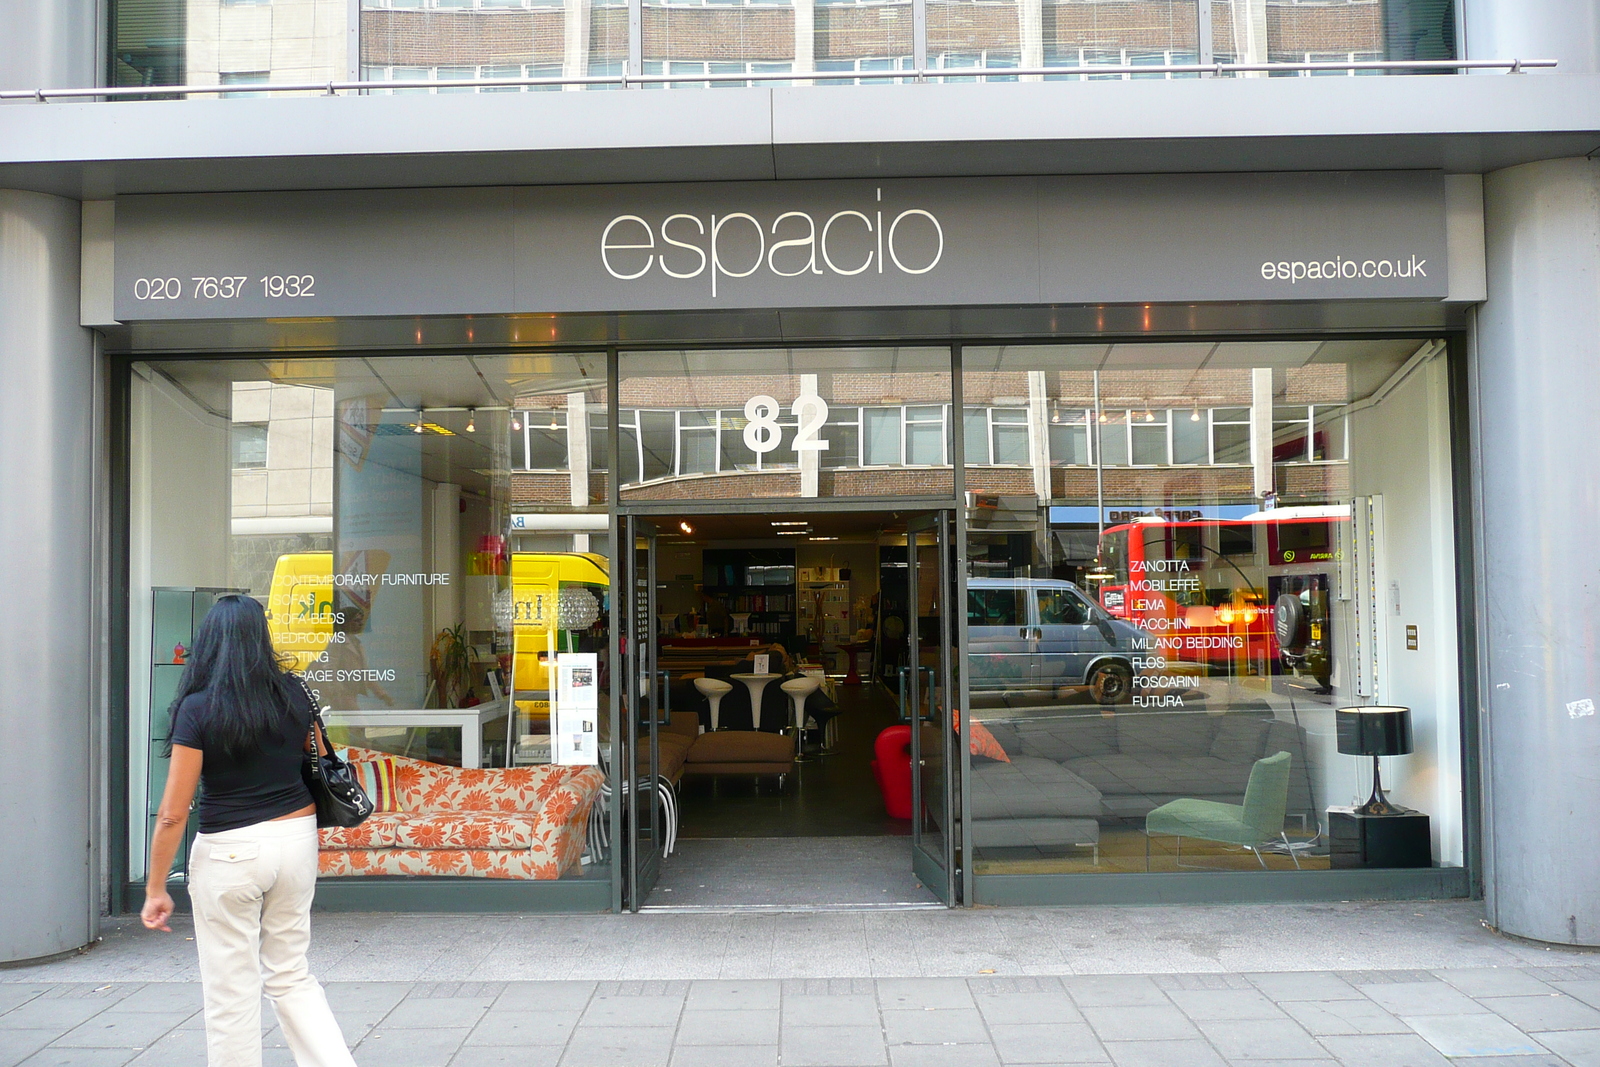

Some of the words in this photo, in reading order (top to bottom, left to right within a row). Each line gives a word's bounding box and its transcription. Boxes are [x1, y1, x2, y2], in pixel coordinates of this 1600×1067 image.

[601, 188, 944, 298] espacio
[1261, 254, 1427, 284] espacio.co.uk
[134, 277, 182, 300] 020
[191, 276, 248, 299] 7637
[259, 274, 315, 298] 1932
[743, 394, 830, 453] 82
[1130, 559, 1190, 573] ZANOTTA
[273, 573, 379, 587] CONTEMPORARY
[381, 573, 450, 586] FURNITURE
[1130, 579, 1200, 592] MOBILEFFE
[273, 593, 315, 606] SOFAS
[1131, 598, 1166, 611] LEMA
[273, 612, 345, 625] SOFA-BEDS
[1131, 617, 1191, 630] TACCHINI
[273, 631, 346, 644] BEDROOMS
[1131, 637, 1184, 650] MILANO
[1186, 636, 1244, 649] BEDDING
[1132, 656, 1166, 669] FLOS
[298, 669, 334, 682] RAGE
[336, 669, 396, 682] SYSTEMS
[1132, 675, 1200, 688] FOSCARINI
[1132, 695, 1185, 708] FUTURA
